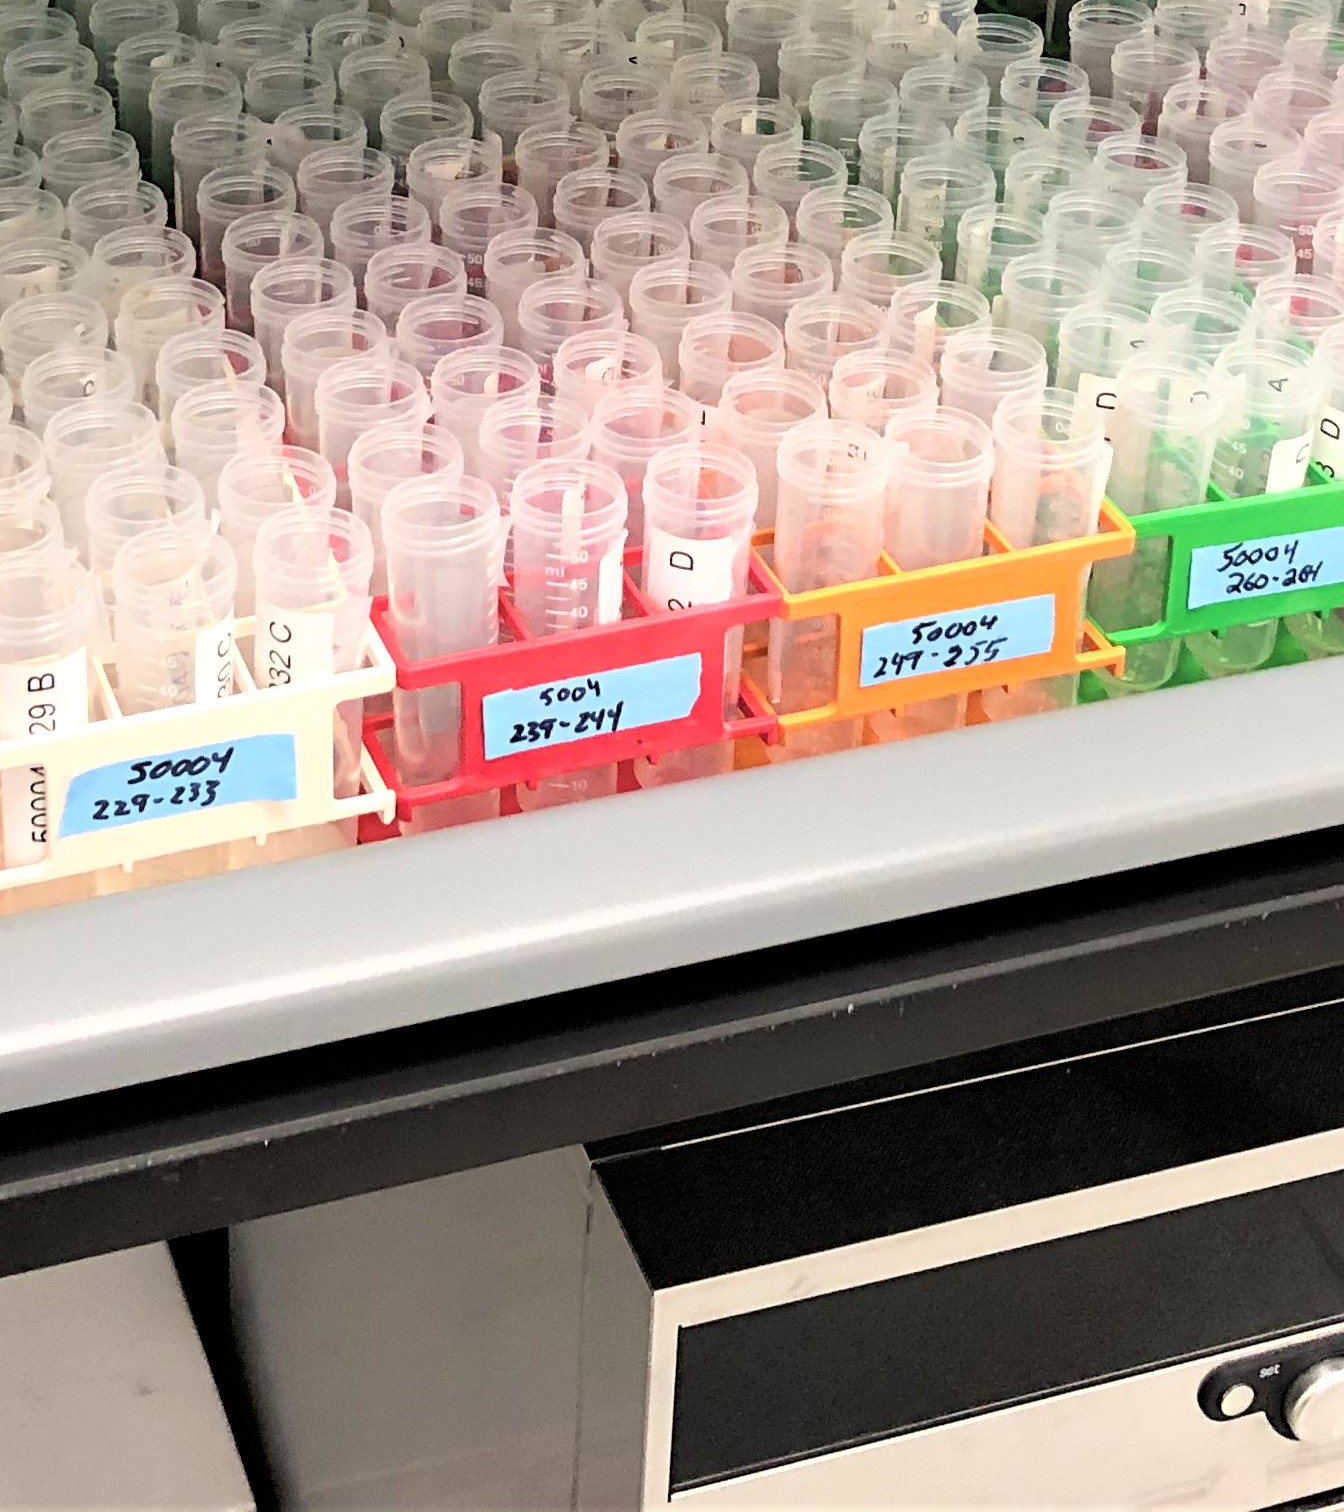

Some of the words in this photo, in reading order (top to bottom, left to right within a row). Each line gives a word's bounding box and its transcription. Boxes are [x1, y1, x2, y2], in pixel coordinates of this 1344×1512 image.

[1320, 418, 1340, 440] D
[669, 550, 694, 571] D
[1216, 540, 1299, 572] 50004
[269, 621, 292, 643] C
[911, 615, 998, 645] 50004
[217, 632, 233, 657] C
[268, 649, 292, 687] 32
[28, 672, 56, 693] B
[540, 678, 601, 706] 5004
[127, 746, 235, 785] 50004
[92, 779, 220, 820] 229-233
[1259, 1363, 1281, 1378] set
